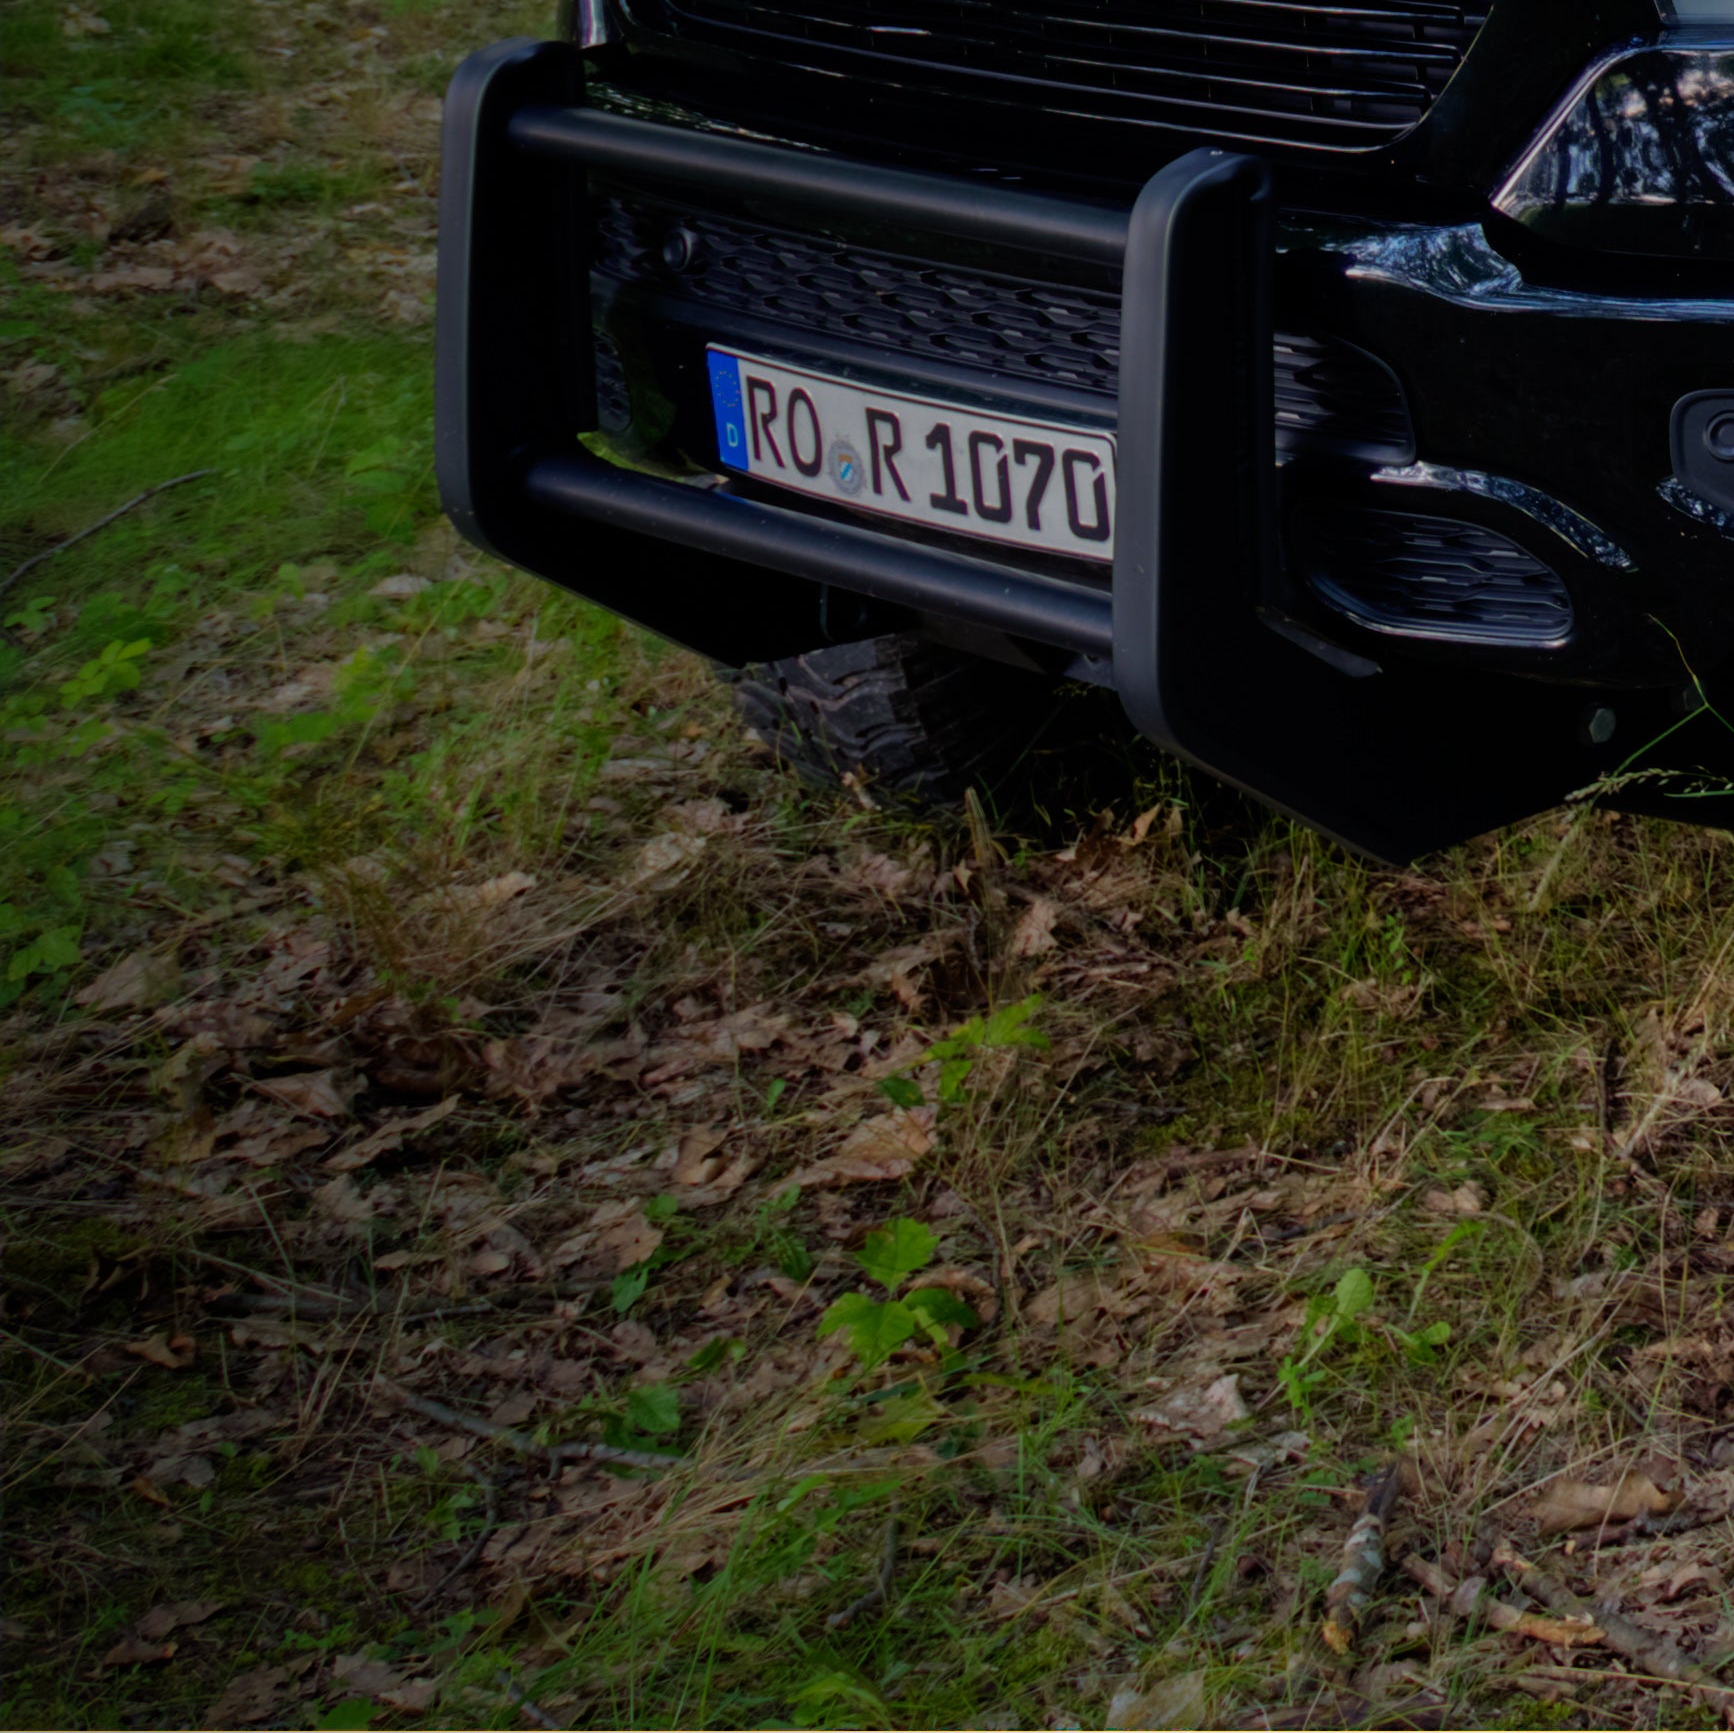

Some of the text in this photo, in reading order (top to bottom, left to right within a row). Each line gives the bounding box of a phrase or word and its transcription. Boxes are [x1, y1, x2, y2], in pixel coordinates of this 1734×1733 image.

[726, 423, 739, 448] D
[746, 375, 1111, 543] RO R 1070
